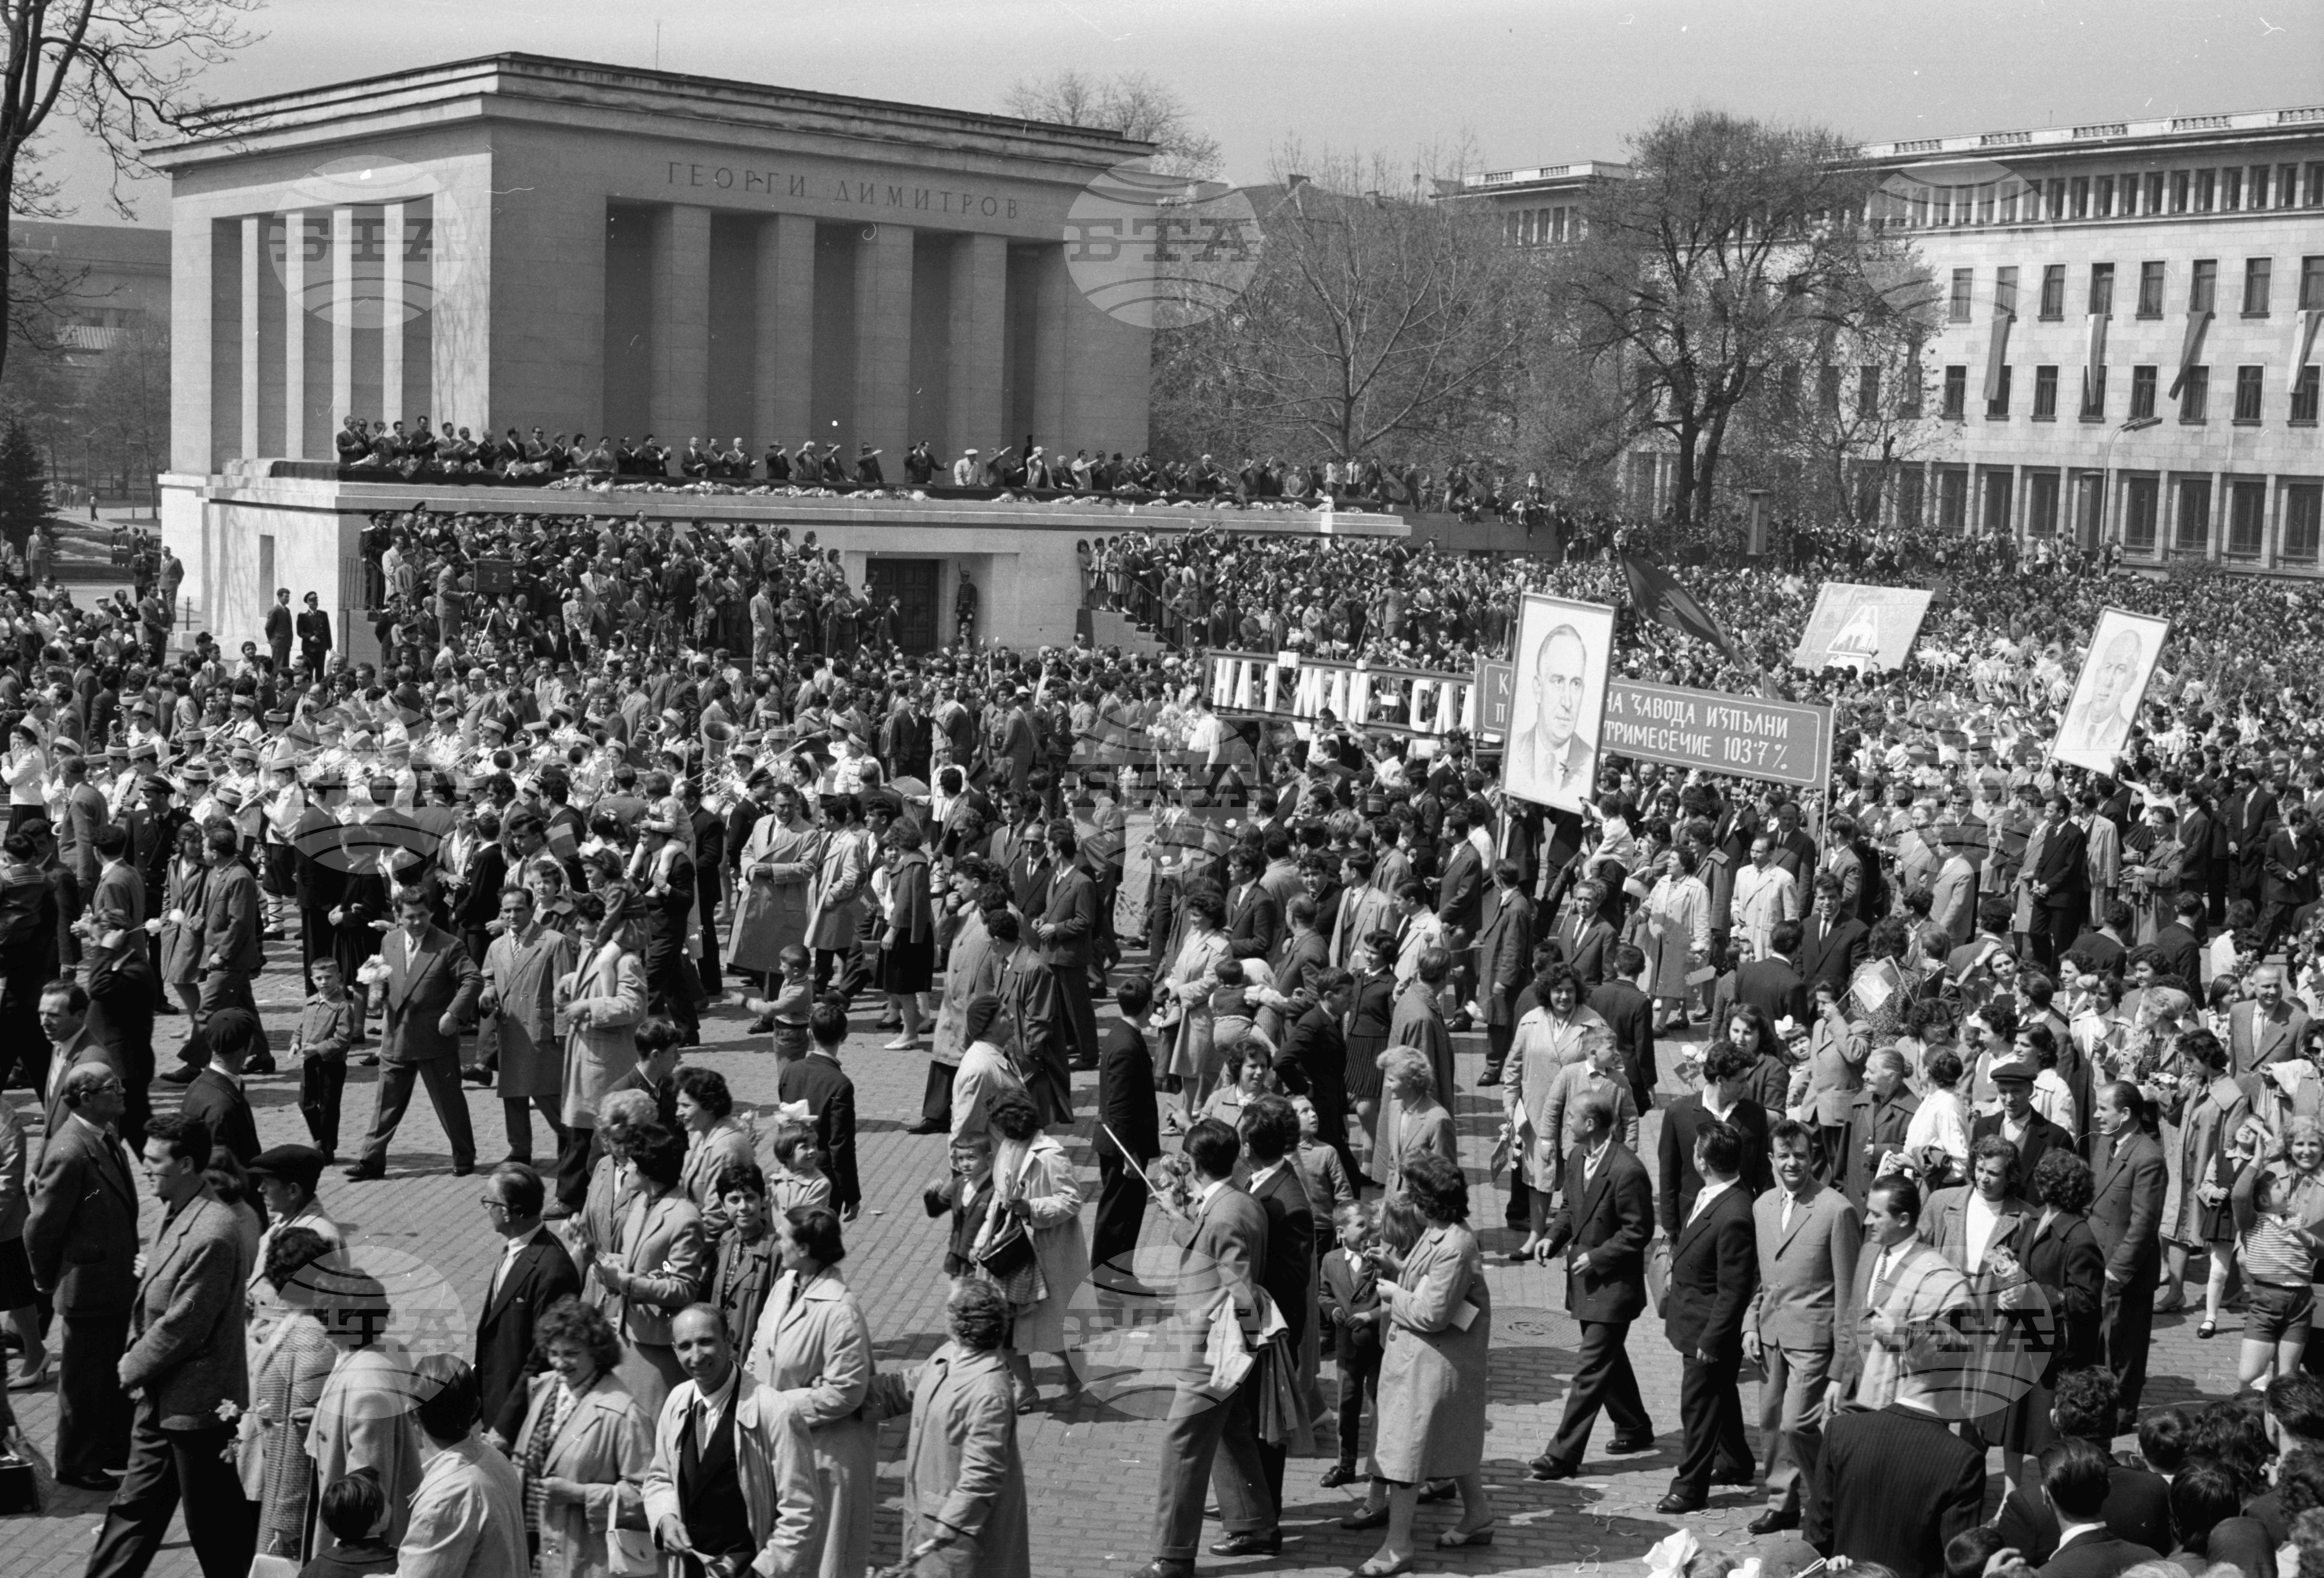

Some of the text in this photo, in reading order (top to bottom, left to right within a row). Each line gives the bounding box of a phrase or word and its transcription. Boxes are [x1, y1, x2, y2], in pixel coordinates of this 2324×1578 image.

[668, 162, 1018, 219] ГЕОРГИ ДИМИТРОВ
[492, 572, 498, 583] 2
[1213, 658, 1249, 709] НА
[1293, 659, 1371, 724] МАЙ
[1410, 679, 1501, 743] СЛА
[1631, 693, 1695, 729] ЗАВОДА
[1706, 705, 1789, 738] ИЗПЪЛНИ
[1604, 720, 1712, 758] ТРИМЕСЕЧИЕ
